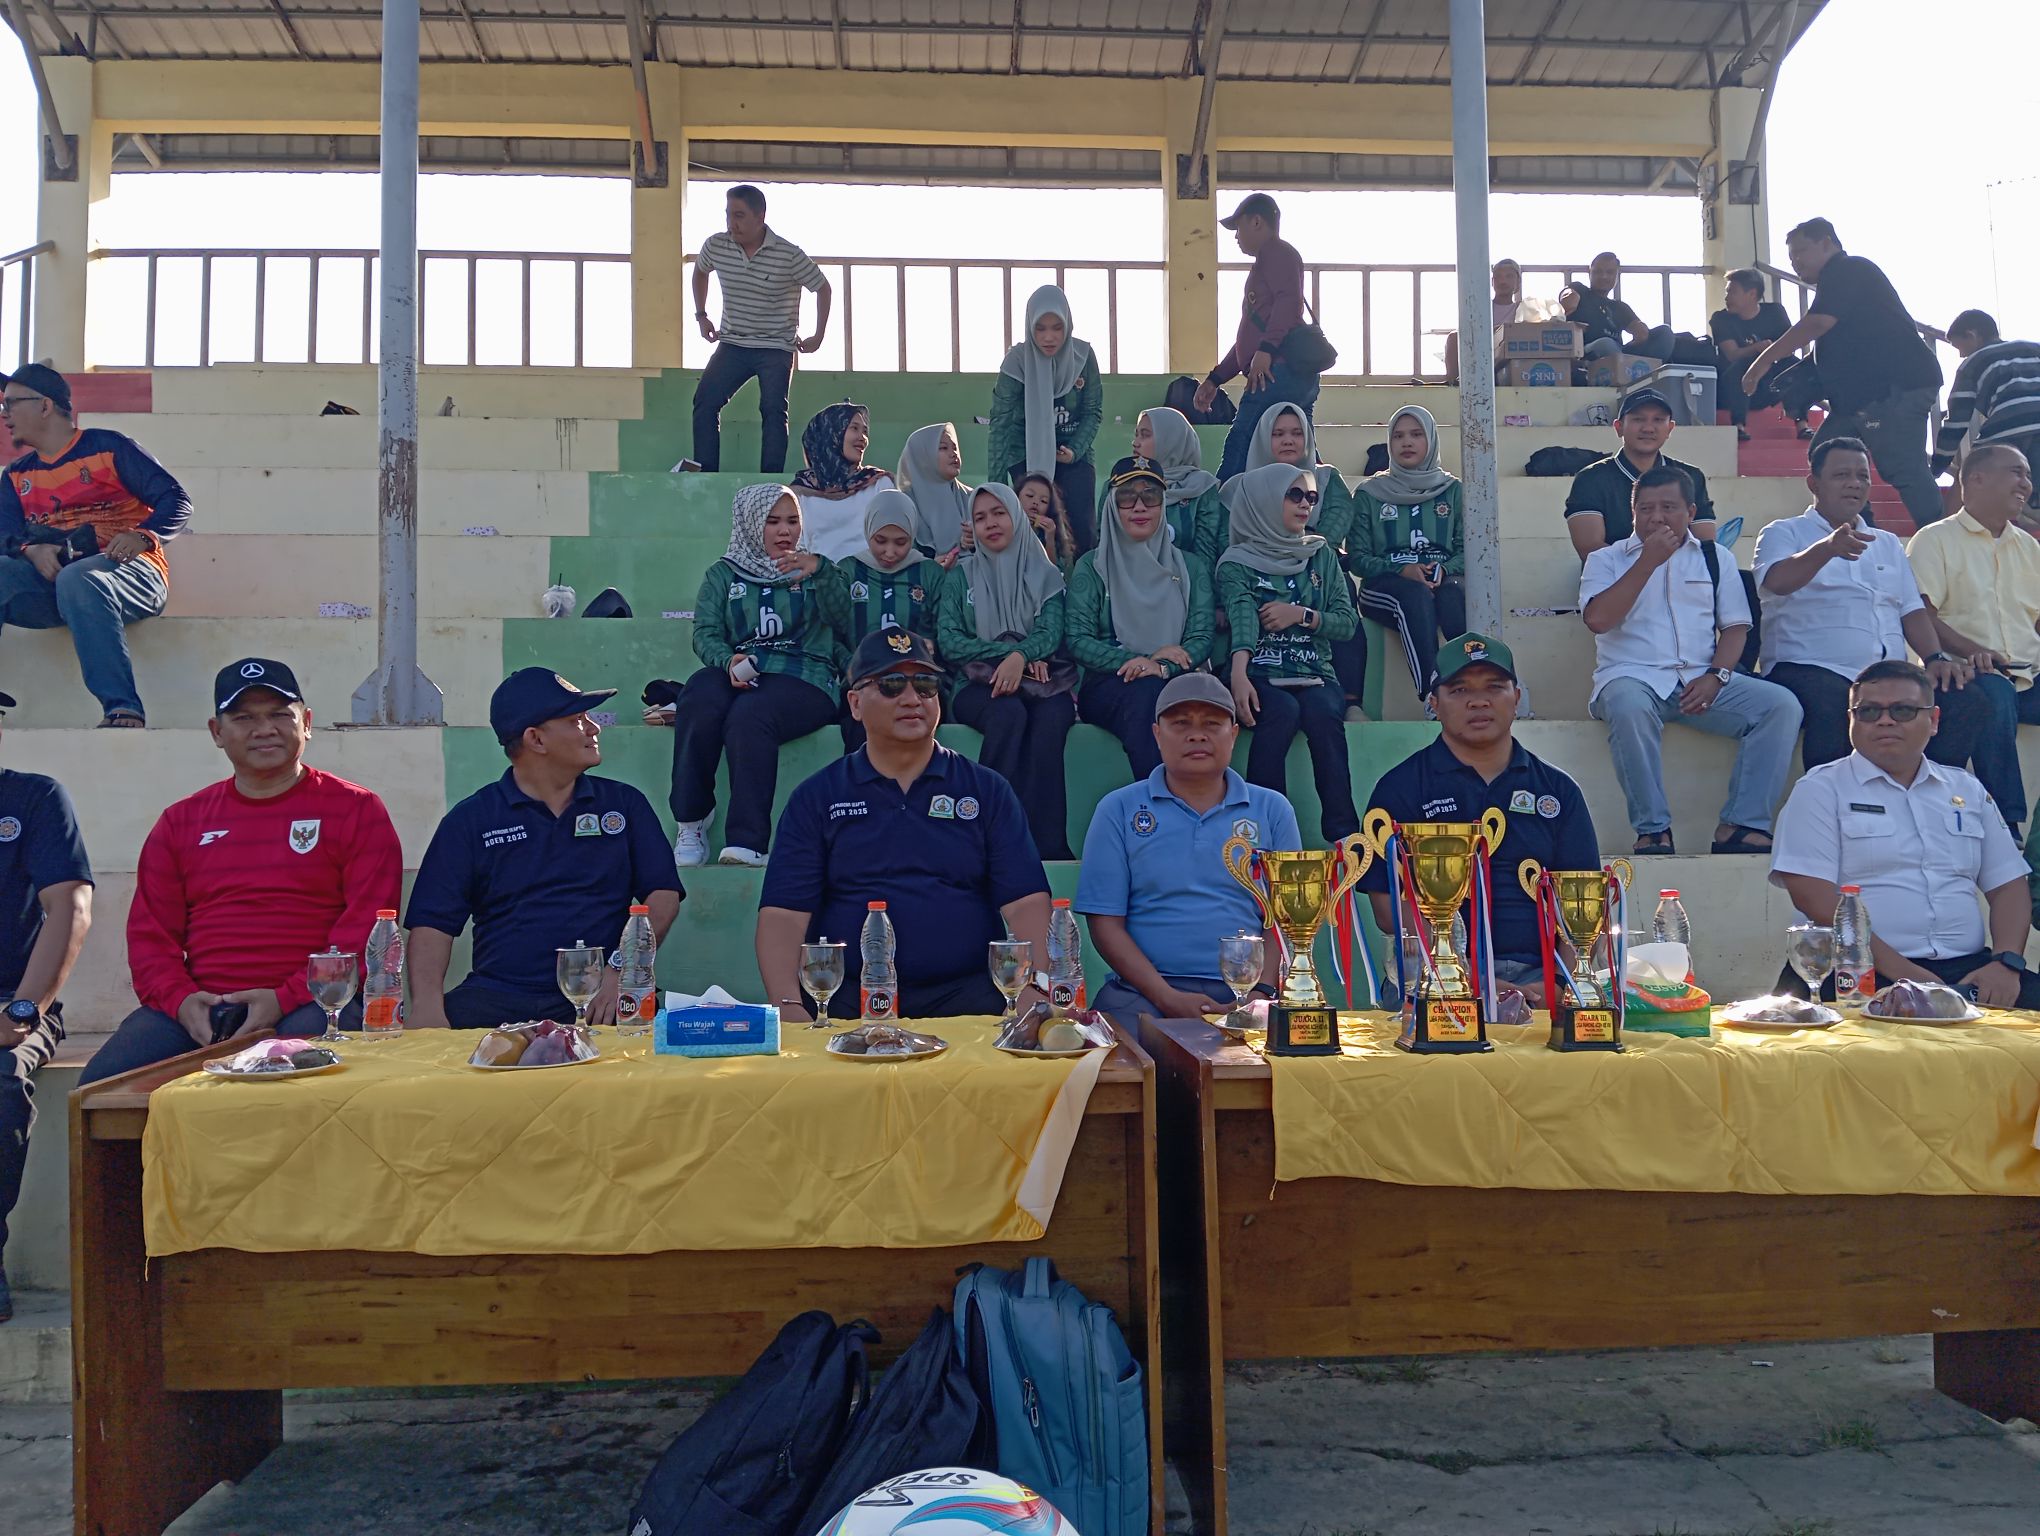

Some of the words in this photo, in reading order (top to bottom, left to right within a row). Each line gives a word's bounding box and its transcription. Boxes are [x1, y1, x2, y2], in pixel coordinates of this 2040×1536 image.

[830, 809, 849, 820] ACEH
[851, 807, 871, 816] 2025
[1441, 804, 1457, 812] 2025
[485, 836, 505, 848] ACEH
[506, 832, 528, 843] 2025
[1838, 976, 1854, 988] Cleo
[1054, 991, 1071, 1002] Cleo
[620, 1000, 636, 1012] Cleo
[872, 998, 889, 1009] Cleo
[1580, 1014, 1600, 1022] JUARA
[678, 1021, 693, 1029] Tisu
[693, 1020, 716, 1031] Wajah
